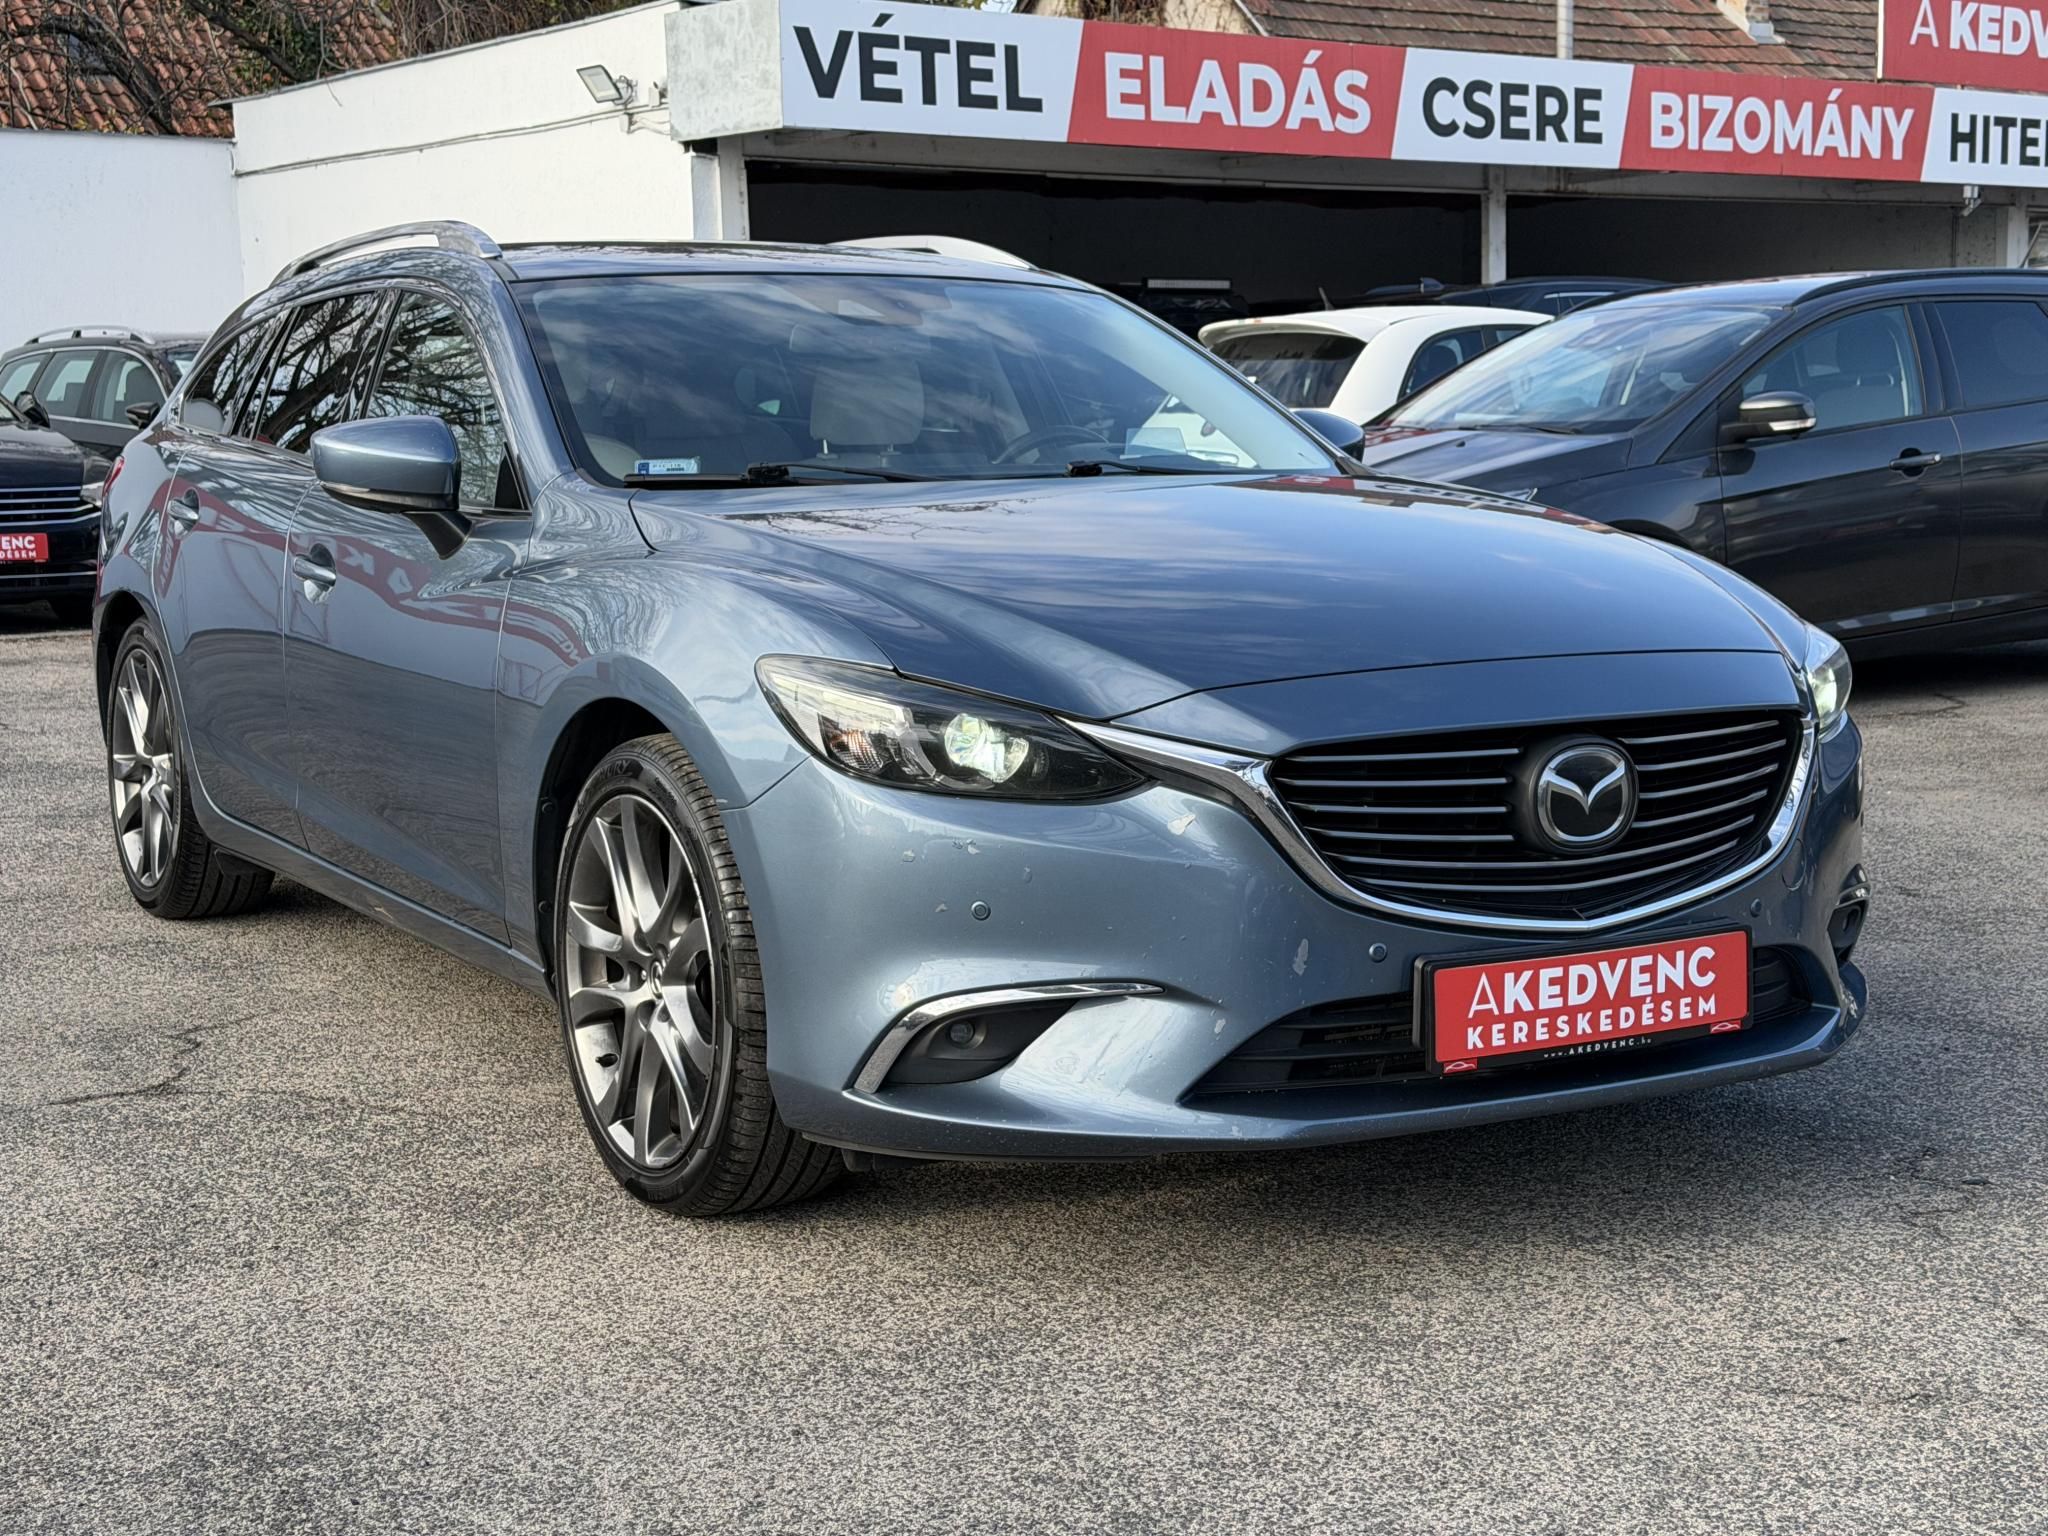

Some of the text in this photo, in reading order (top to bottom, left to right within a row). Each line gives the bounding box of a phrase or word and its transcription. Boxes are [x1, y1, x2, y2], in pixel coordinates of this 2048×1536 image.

[1909, 0, 1939, 48] A
[793, 13, 2048, 168] VÉTEL ELADÁS CSERE BIZOMÁNY HITE
[1467, 994, 1716, 1050] KERESKEDÉSEM
